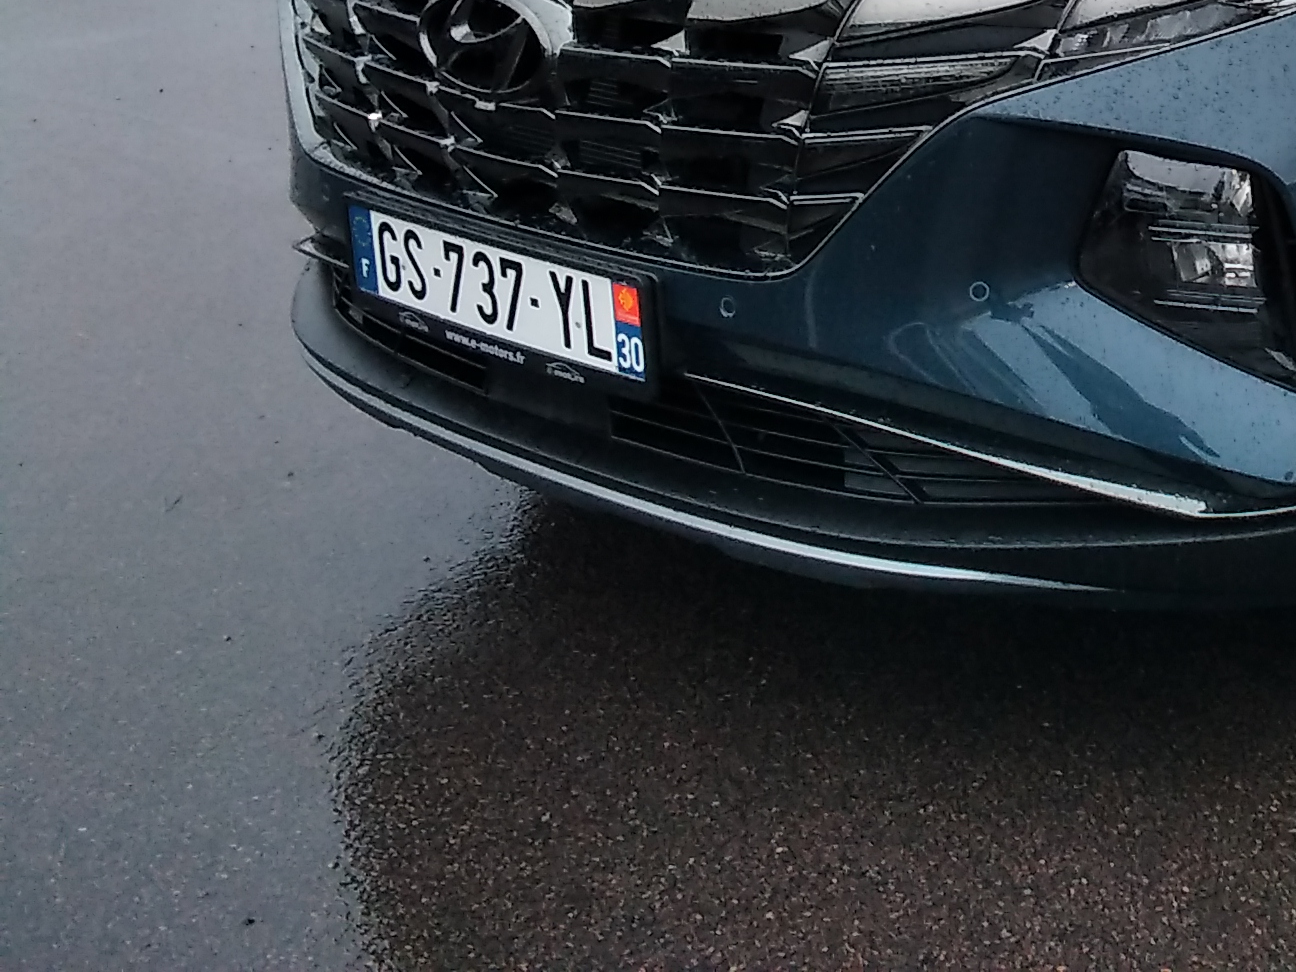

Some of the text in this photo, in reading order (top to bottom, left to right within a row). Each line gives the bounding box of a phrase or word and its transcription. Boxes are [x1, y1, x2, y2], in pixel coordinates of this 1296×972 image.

[361, 257, 370, 278] F
[377, 221, 613, 363] GS-737-YL
[617, 332, 645, 373] 30
